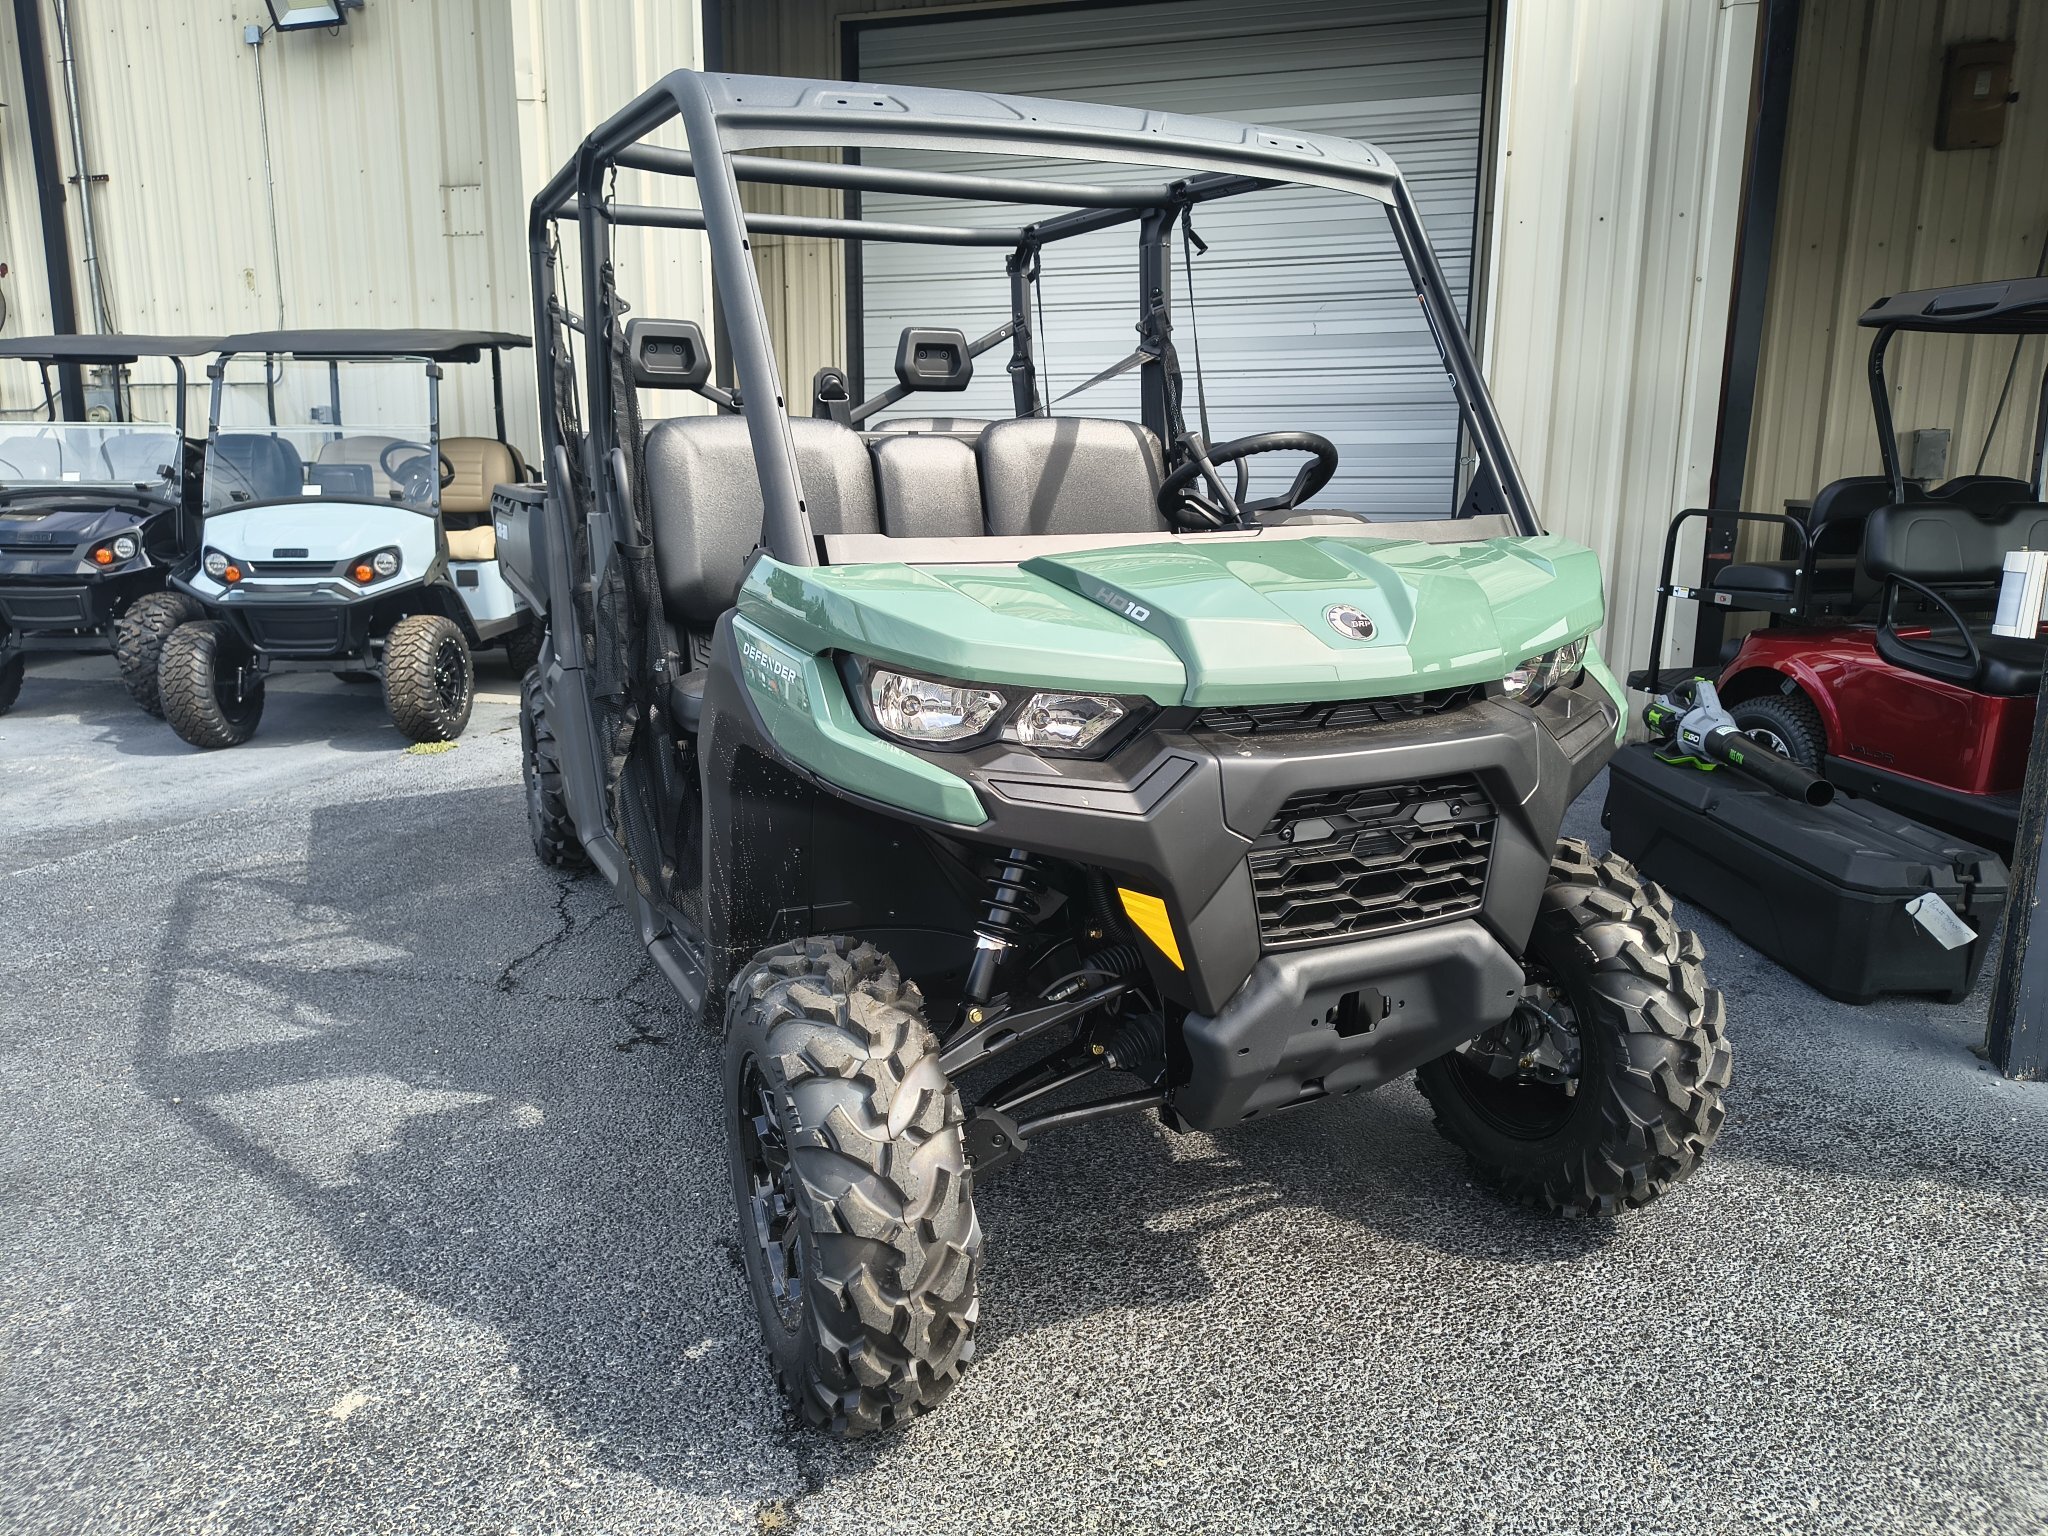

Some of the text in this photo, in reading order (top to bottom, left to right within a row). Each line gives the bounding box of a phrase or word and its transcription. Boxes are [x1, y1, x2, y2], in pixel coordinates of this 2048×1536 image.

[1096, 587, 1150, 622] HD10
[743, 641, 797, 684] DEFENDER
[1683, 731, 1700, 743] EGO
